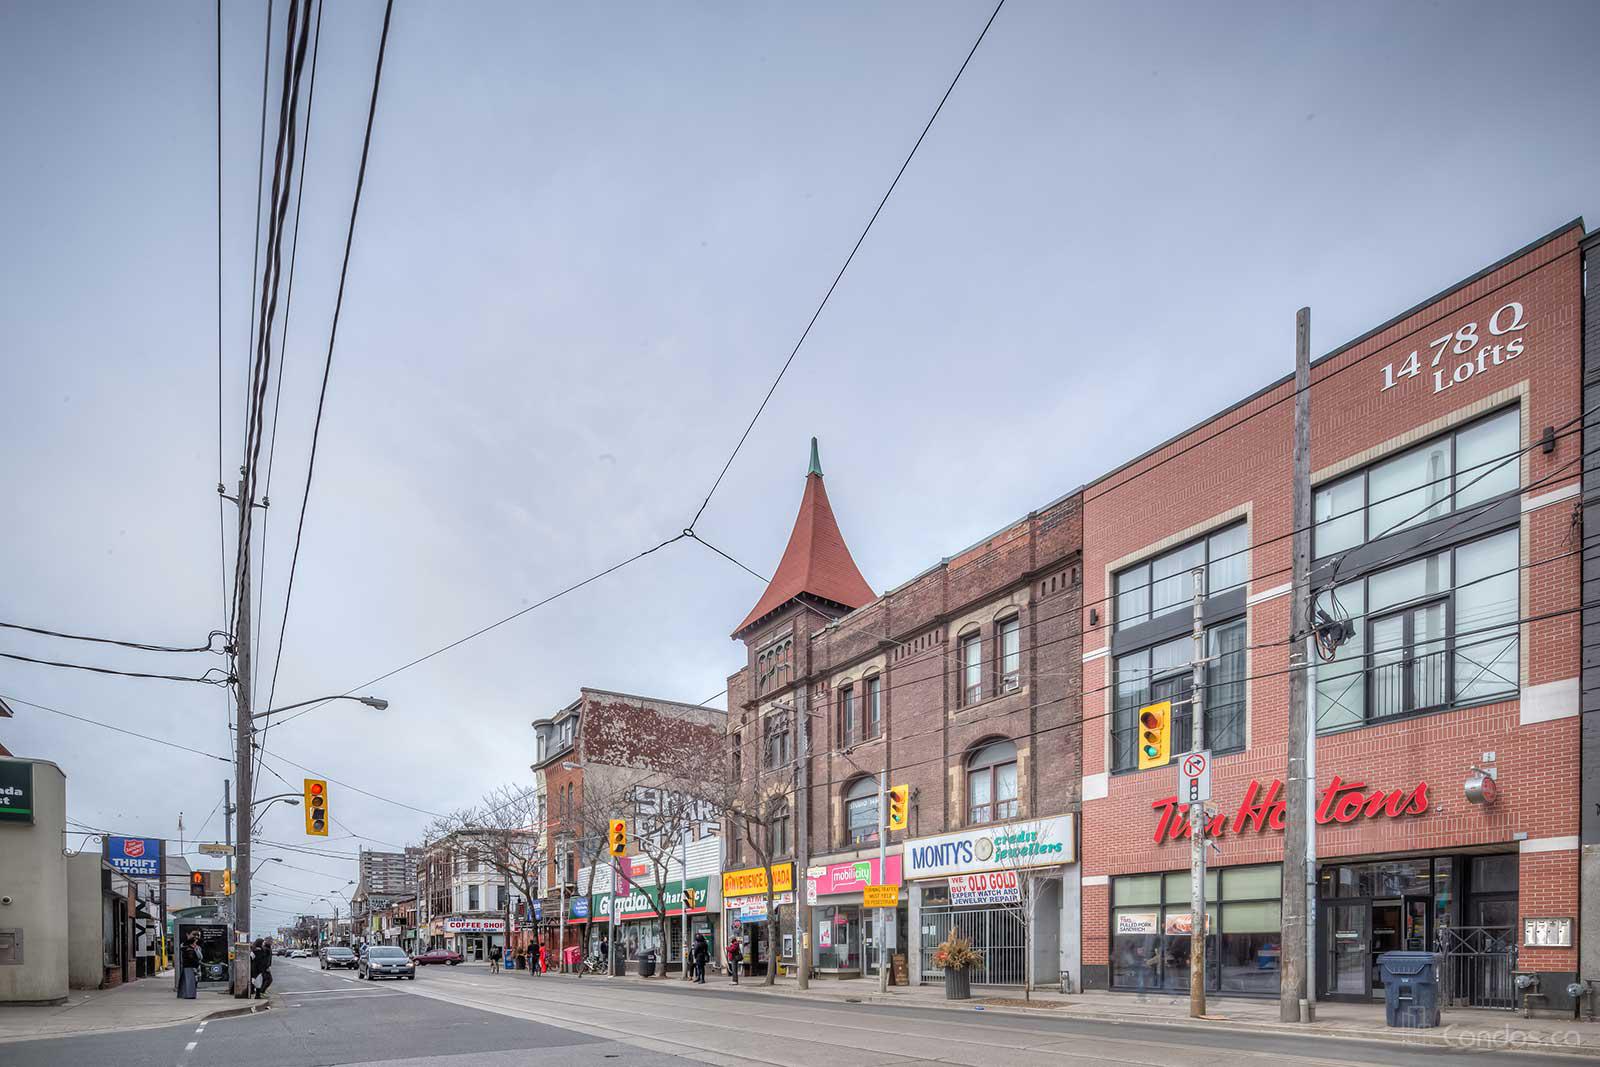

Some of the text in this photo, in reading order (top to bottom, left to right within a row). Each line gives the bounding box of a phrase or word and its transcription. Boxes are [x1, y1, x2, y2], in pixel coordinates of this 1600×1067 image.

[1488, 302, 1529, 336] Q
[1432, 337, 1525, 395] Lofts
[1232, 775, 1429, 834] Hotons
[994, 831, 1038, 846] credit
[112, 858, 157, 867] THRIFT
[912, 840, 973, 869] MONTY'S
[764, 869, 790, 887] CNADA
[833, 868, 869, 881] mobilicity
[968, 872, 1017, 891] OLD GOLD
[954, 897, 987, 905] JEWELRY
